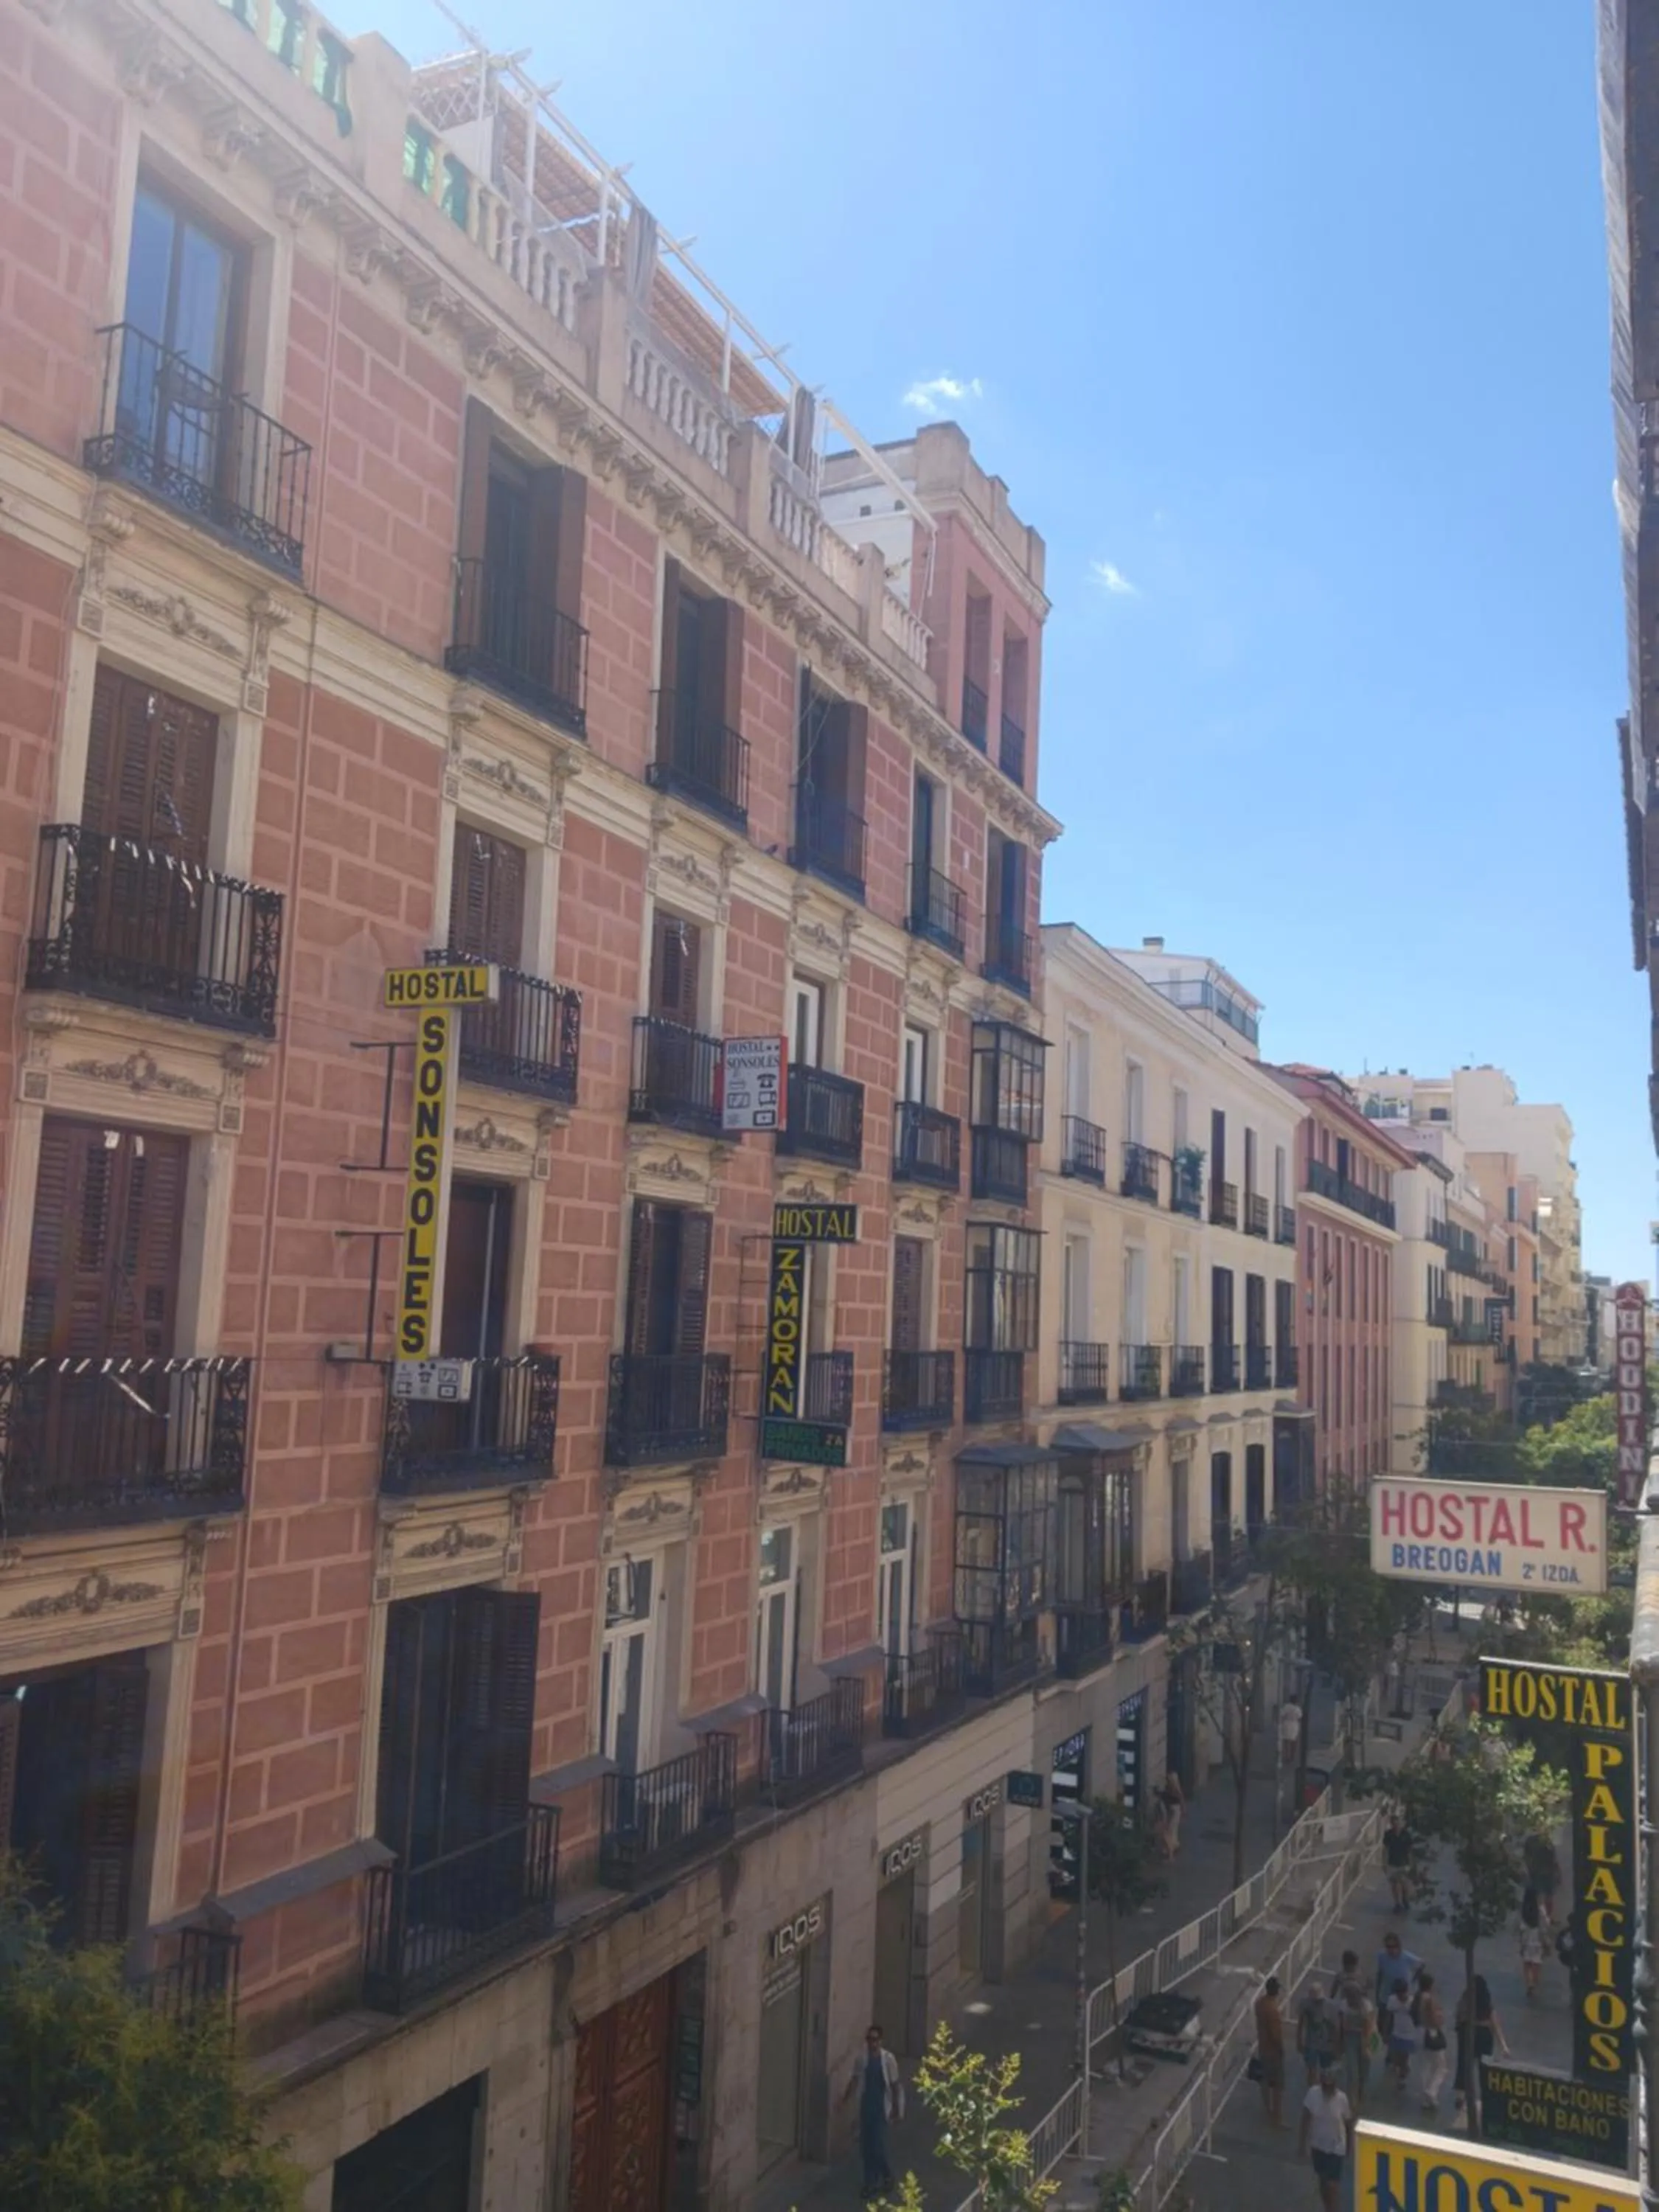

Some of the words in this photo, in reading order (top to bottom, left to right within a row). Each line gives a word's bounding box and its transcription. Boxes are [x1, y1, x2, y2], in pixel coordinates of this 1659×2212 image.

[388, 970, 486, 1002] HOSTAL
[401, 1015, 445, 1355] SONSOLES
[773, 1207, 855, 1239] HOSTAL
[768, 1247, 801, 1415] ZAMORAN
[1618, 1309, 1644, 1500] HOODINI
[1380, 1489, 1545, 1549] HOSTAL
[1559, 1501, 1598, 1553] R.
[1391, 1543, 1502, 1577] BREOGAN
[1486, 1666, 1627, 1731] HOSTAL
[773, 1905, 821, 1963] IQOS
[1583, 1742, 1627, 2072] PALACIOS
[1487, 2070, 1630, 2118] HABITACIONES
[1507, 2099, 1548, 2127] CON
